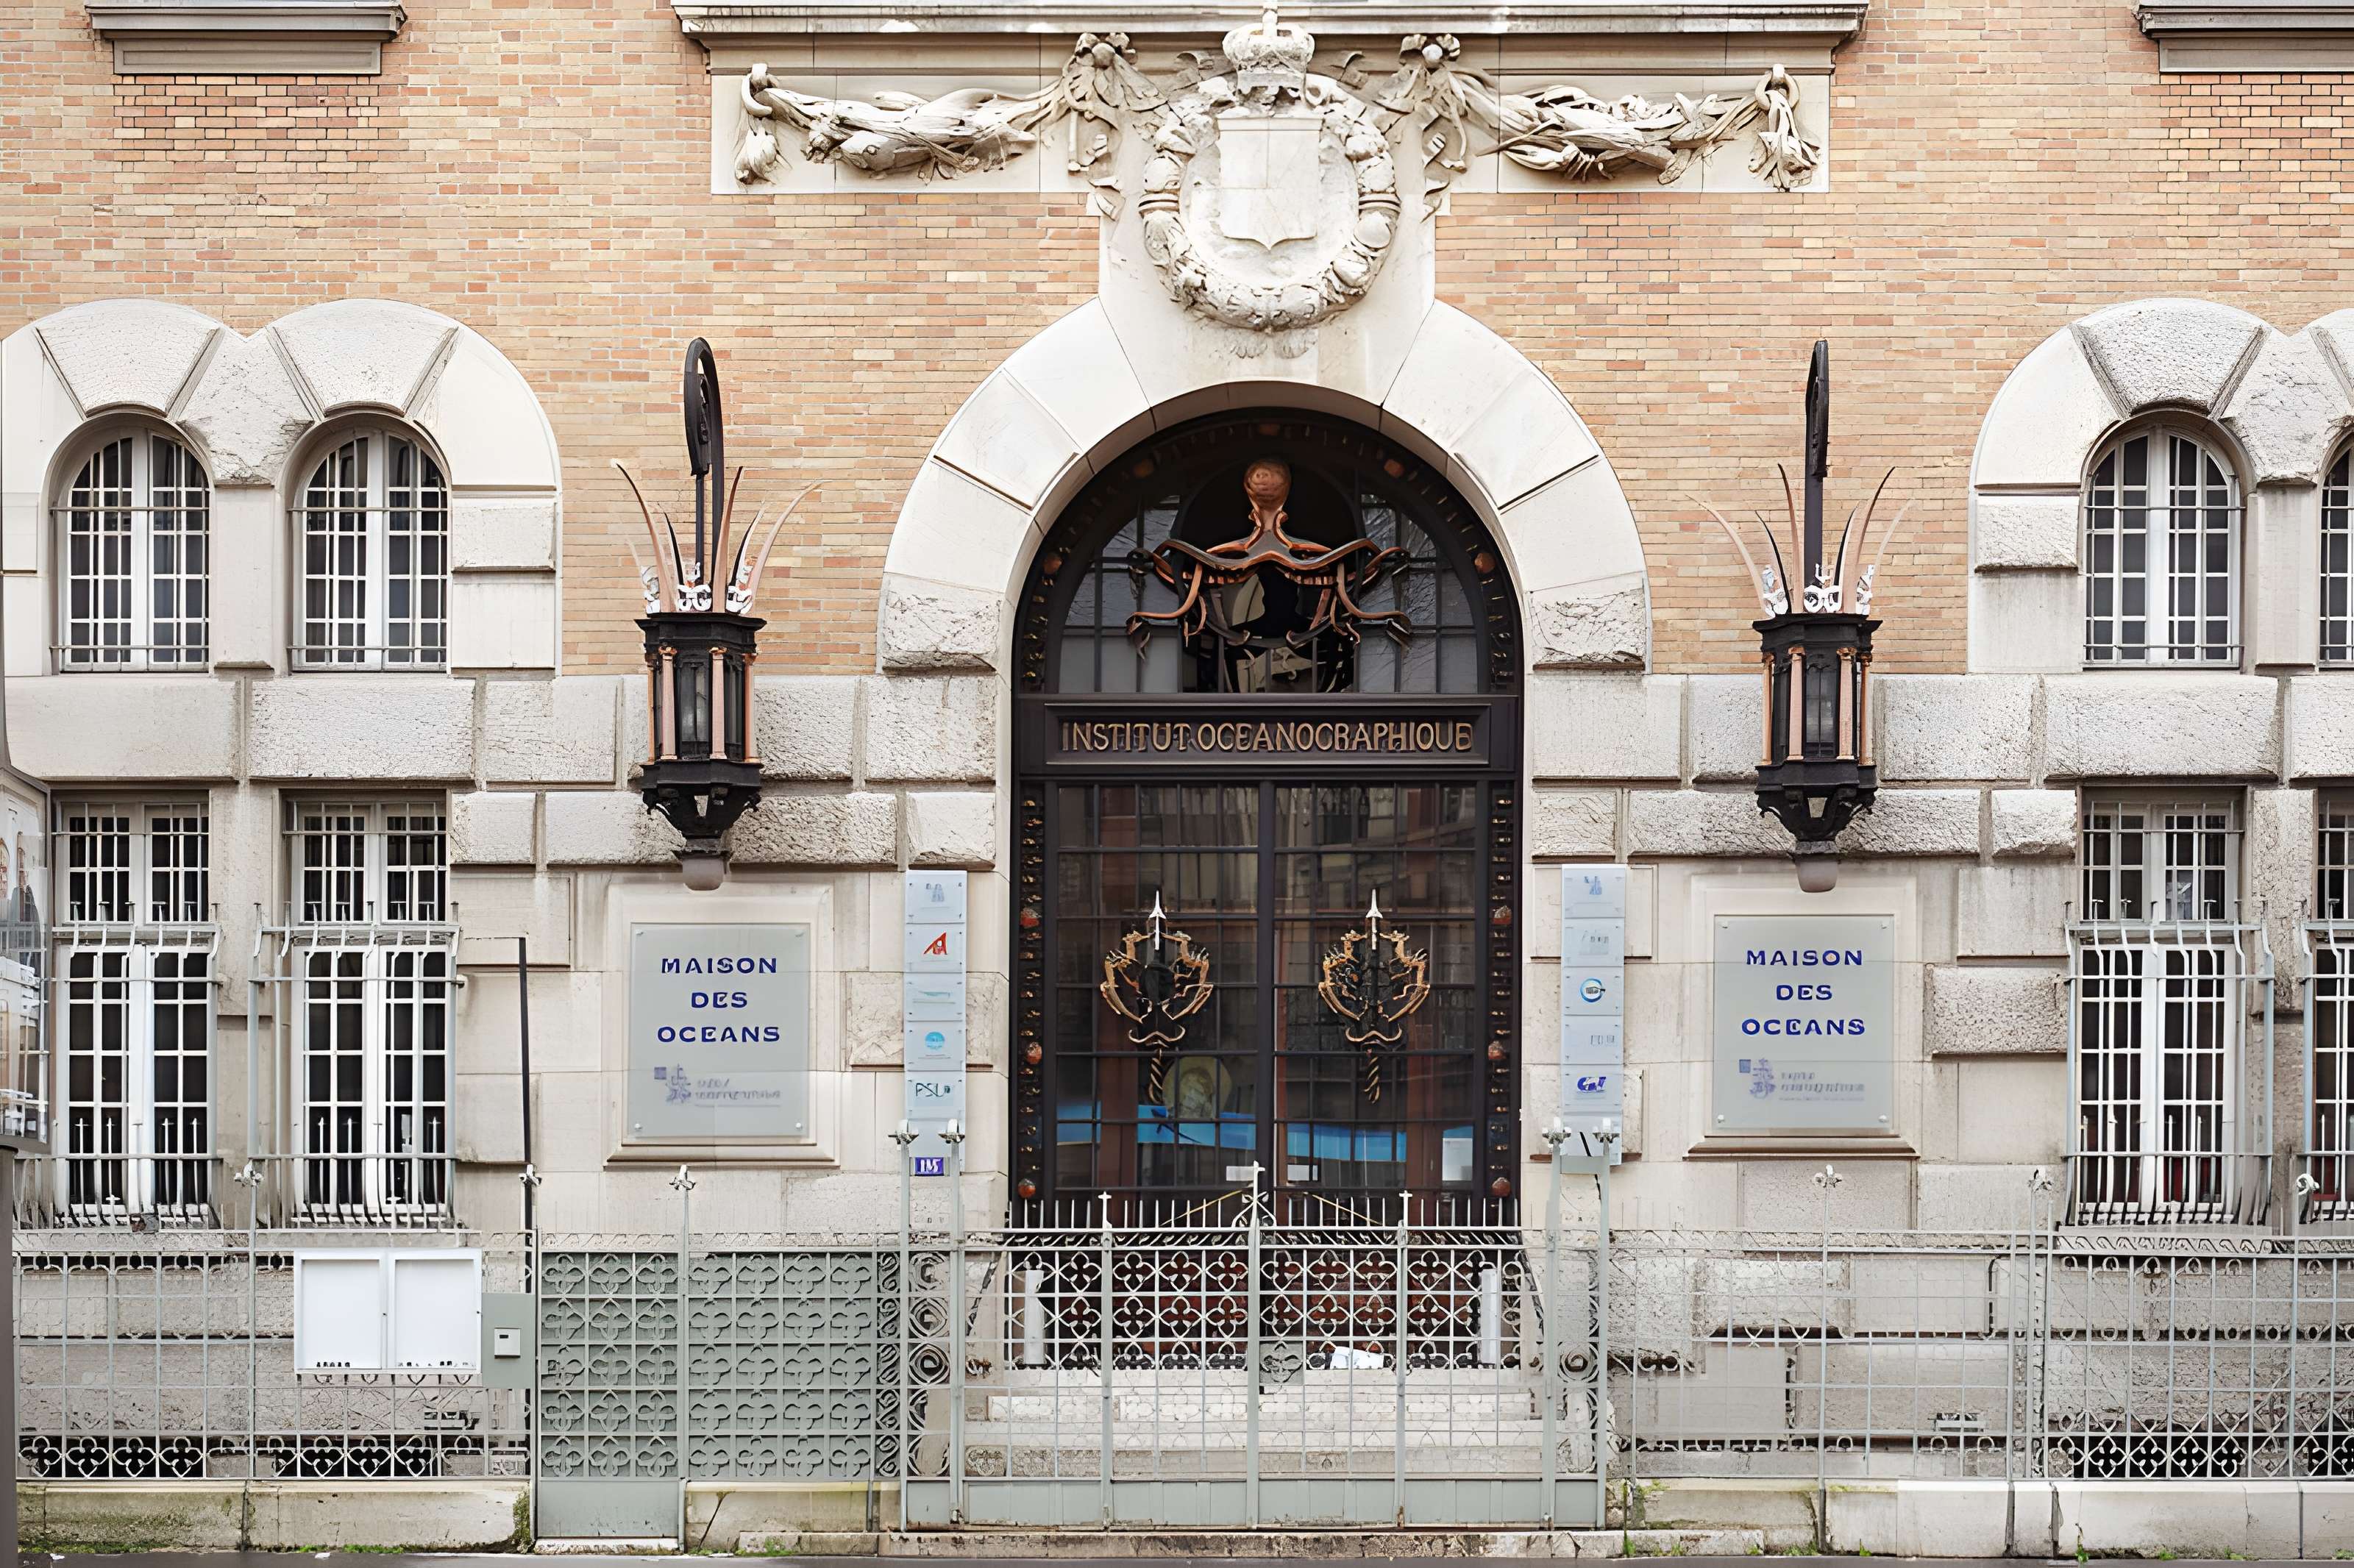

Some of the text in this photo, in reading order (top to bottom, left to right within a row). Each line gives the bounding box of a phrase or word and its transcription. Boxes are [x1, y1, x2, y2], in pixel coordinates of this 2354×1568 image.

[1062, 722, 1192, 751] INSTITUT
[661, 958, 777, 974] MAISON
[1746, 949, 1863, 966] MAISON
[691, 991, 747, 1008] DES
[1776, 984, 1832, 1000] DES
[657, 1026, 780, 1043] OCEANS
[1741, 1018, 1865, 1036] OCEANS
